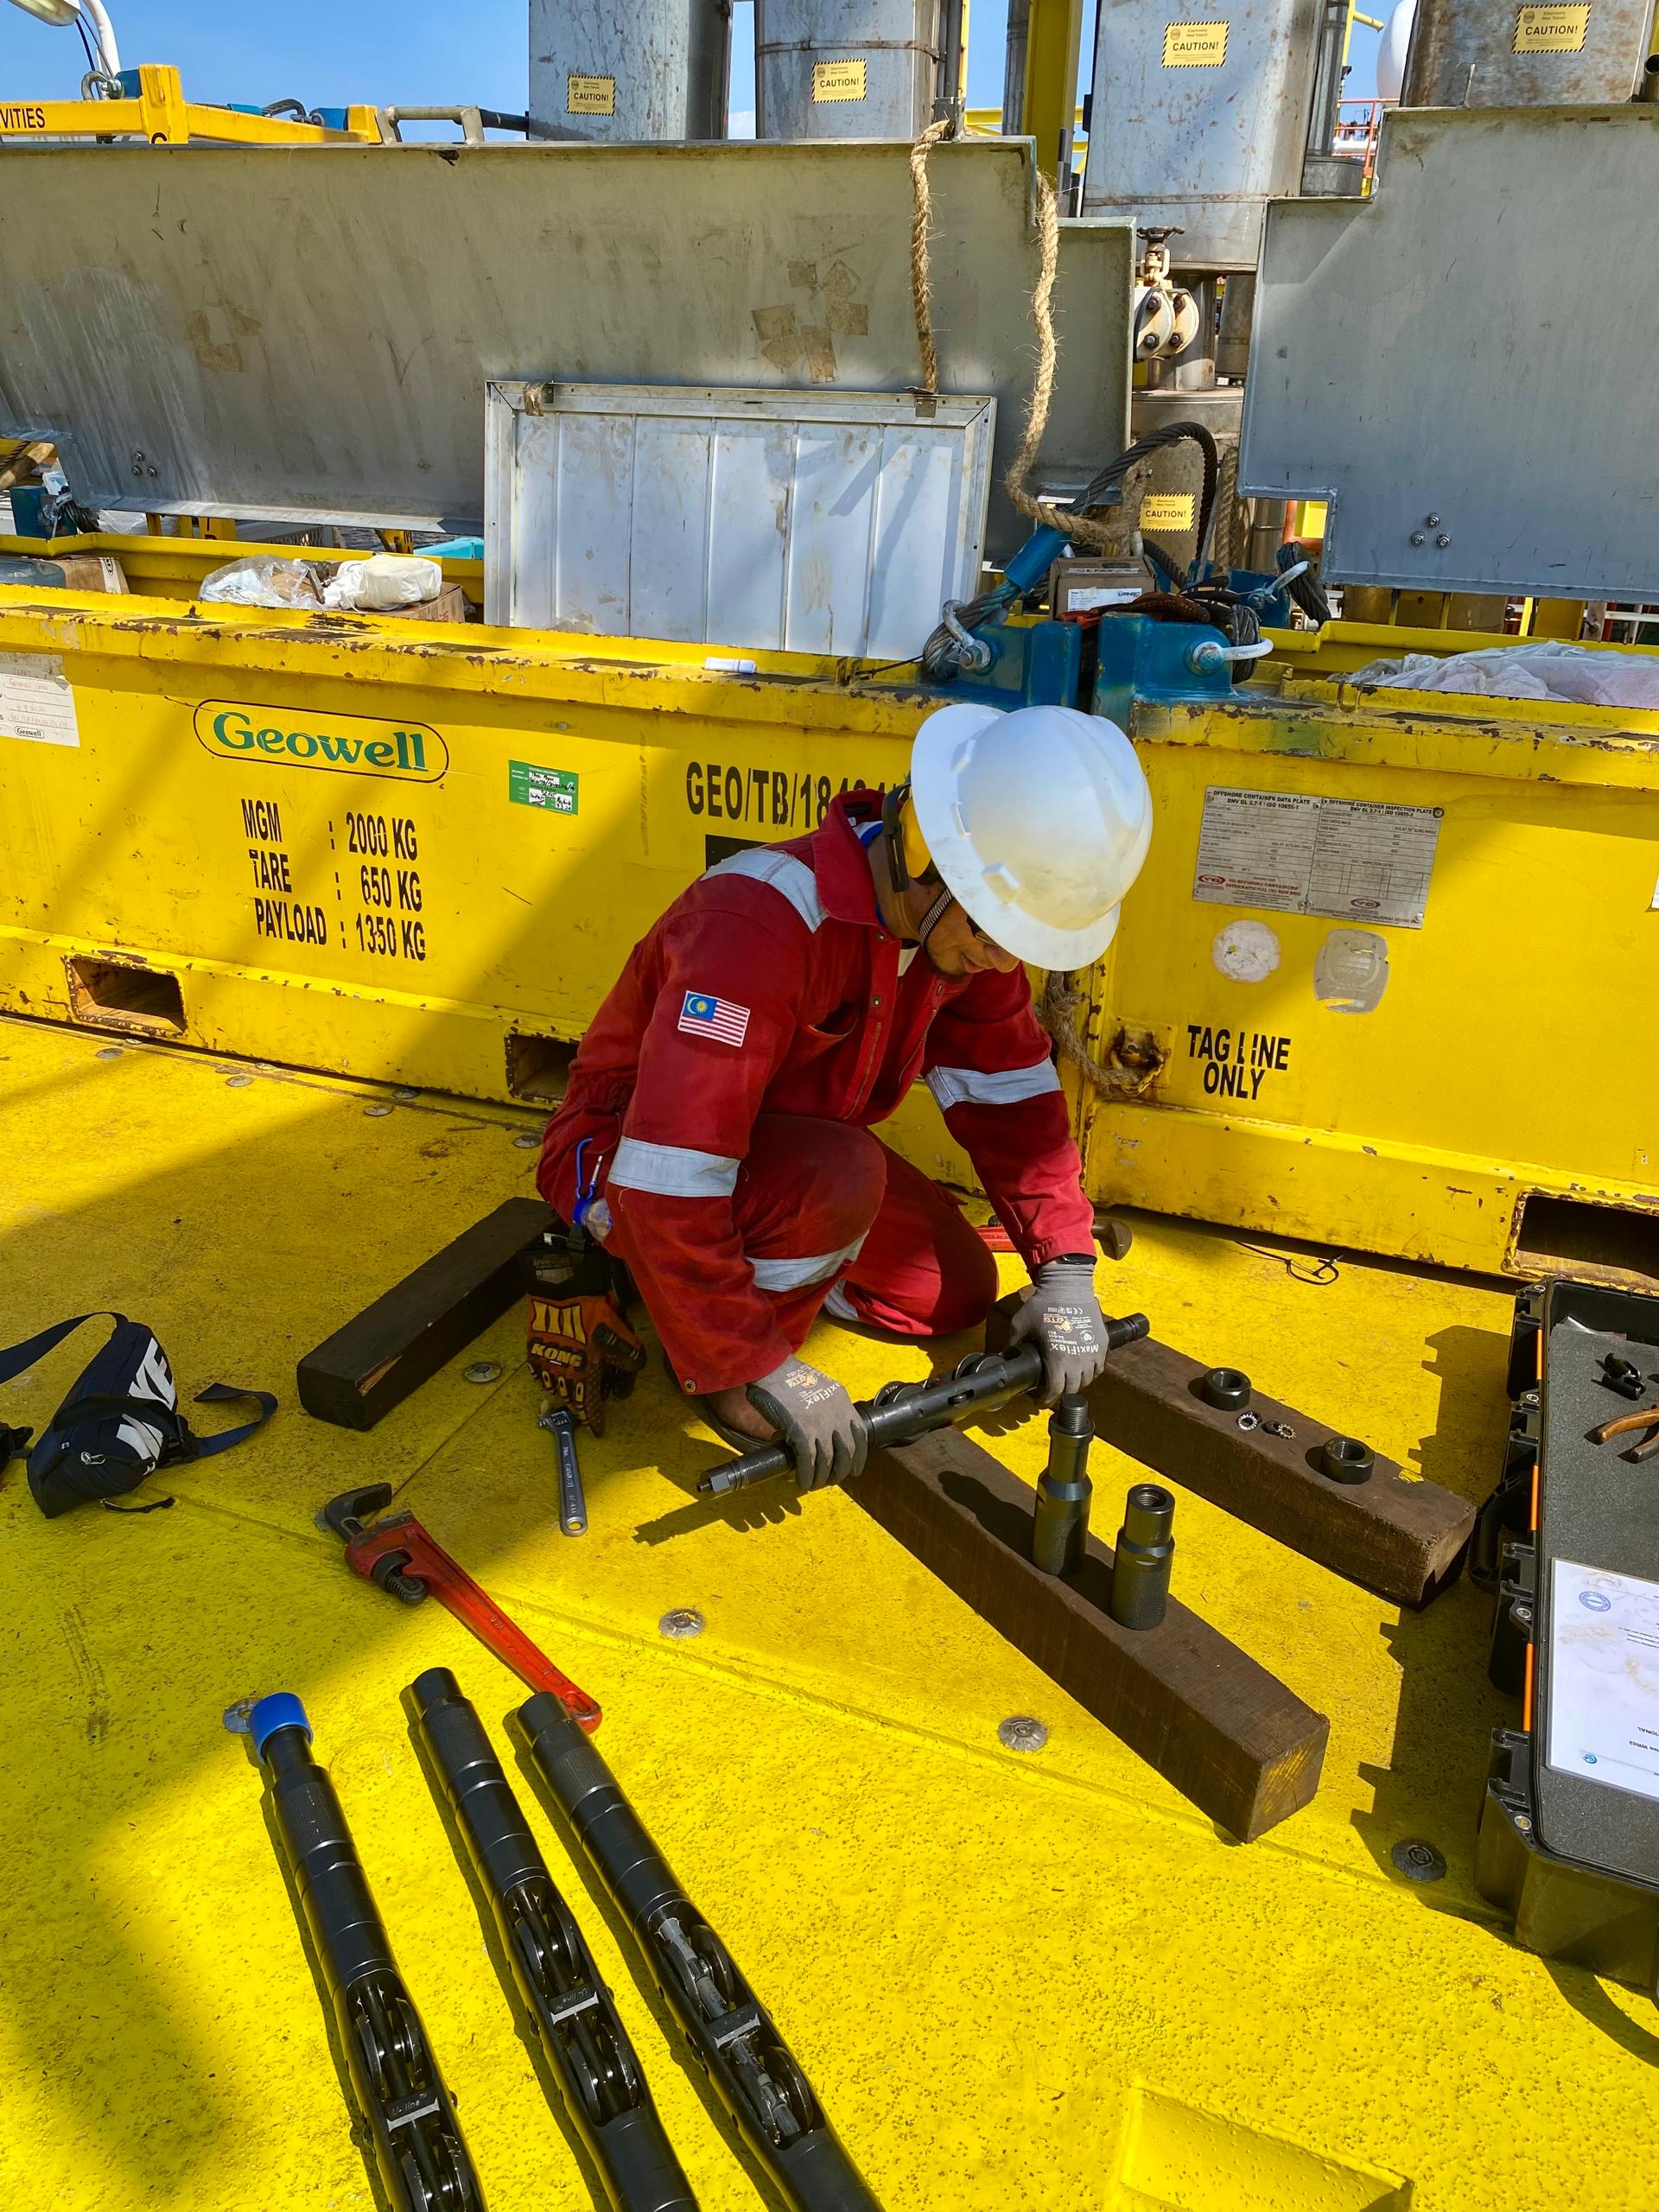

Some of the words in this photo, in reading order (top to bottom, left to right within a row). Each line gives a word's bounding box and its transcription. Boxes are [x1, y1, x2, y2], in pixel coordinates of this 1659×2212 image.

[1525, 25, 1578, 35] CAUTION!
[1173, 41, 1219, 51] CAUTION!
[820, 78, 859, 88] CAUTION!
[574, 92, 609, 102] CAUTION!
[16, 728, 41, 736] Geowell
[213, 711, 429, 772] Geowell
[240, 798, 283, 842] MGM
[346, 811, 388, 857] 2000
[391, 817, 418, 861] KG
[249, 849, 292, 893] TARE
[360, 864, 392, 908] 650
[397, 870, 423, 912] KG
[254, 897, 327, 945] PAYLOAD
[356, 912, 397, 957] 1350
[401, 919, 426, 962] KG
[1187, 1024, 1230, 1062] TAG
[1236, 1032, 1291, 1071] LINE
[1204, 1062, 1266, 1101] ONLY
[531, 1343, 582, 1368] KONG
[1051, 1343, 1099, 1356] MaxiFlex
